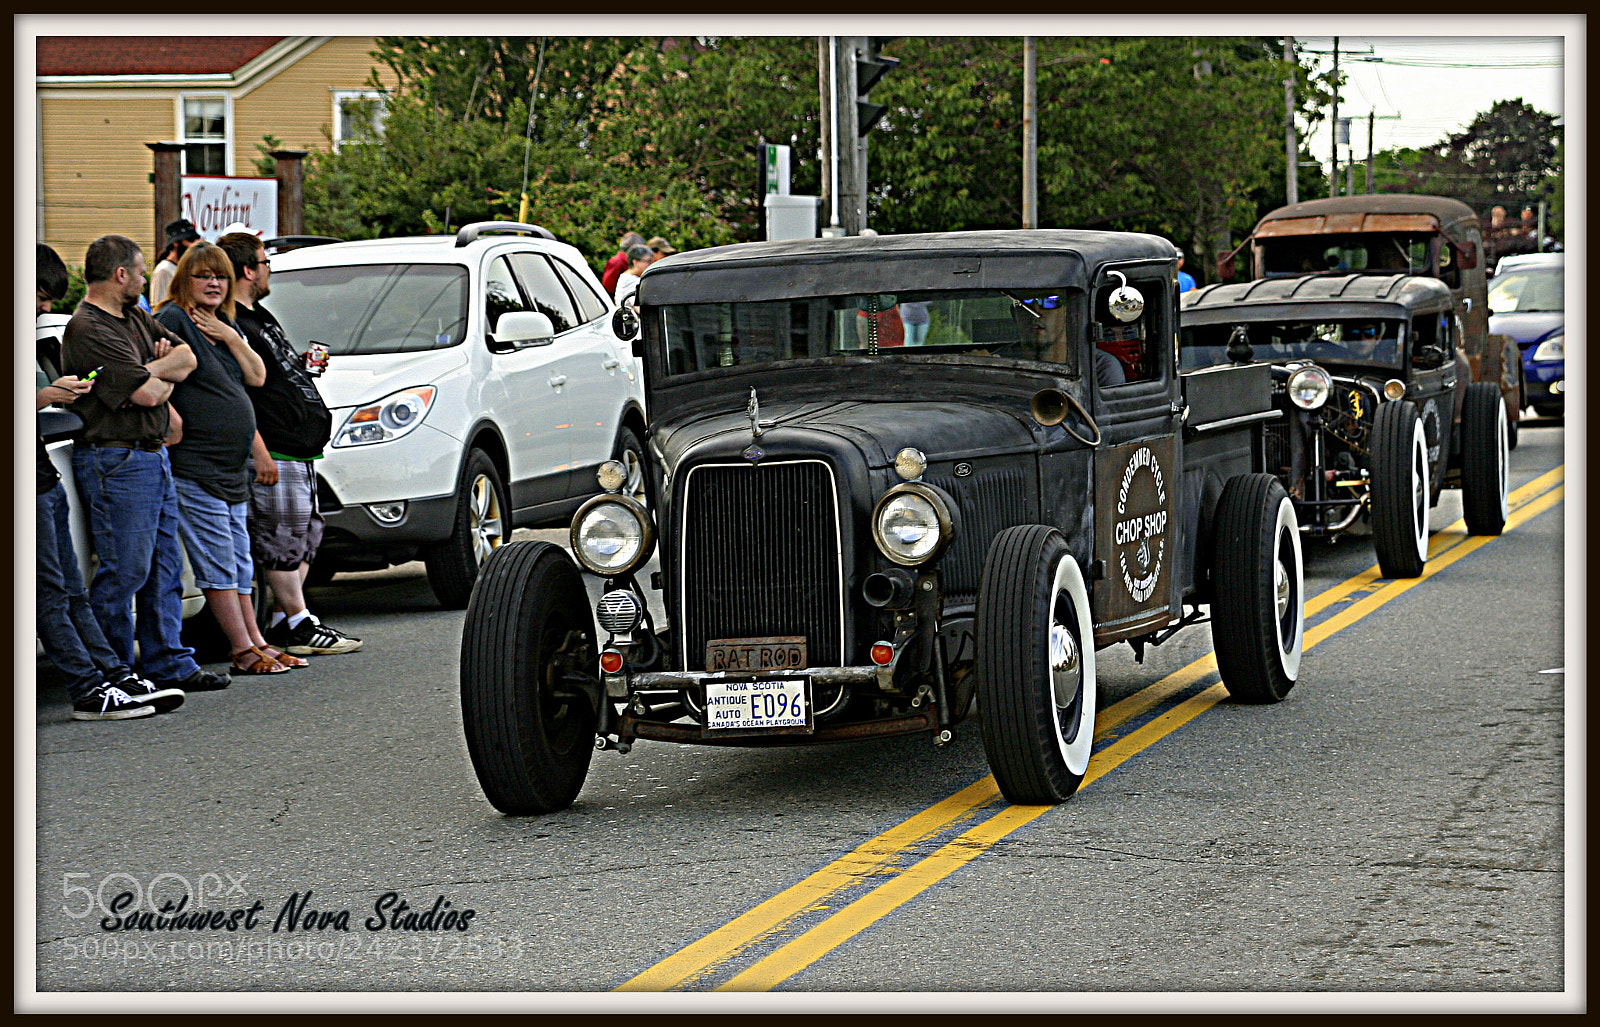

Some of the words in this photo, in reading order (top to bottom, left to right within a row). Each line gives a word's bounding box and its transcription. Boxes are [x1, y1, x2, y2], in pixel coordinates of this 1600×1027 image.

[1117, 447, 1151, 514] CONDEMNED
[1151, 455, 1166, 505] CYCLE
[1115, 518, 1143, 545] CHOP
[1144, 511, 1167, 537] SHOP
[713, 648, 755, 670] RAT
[760, 647, 802, 668] ROD
[726, 682, 748, 692] NOVA
[752, 681, 785, 691] SCOTIA
[707, 695, 748, 705] ANTIQUE
[750, 692, 802, 720] E096
[715, 709, 741, 720] AUTO
[707, 721, 741, 729] CANADA'S
[742, 719, 765, 727] OCEAN
